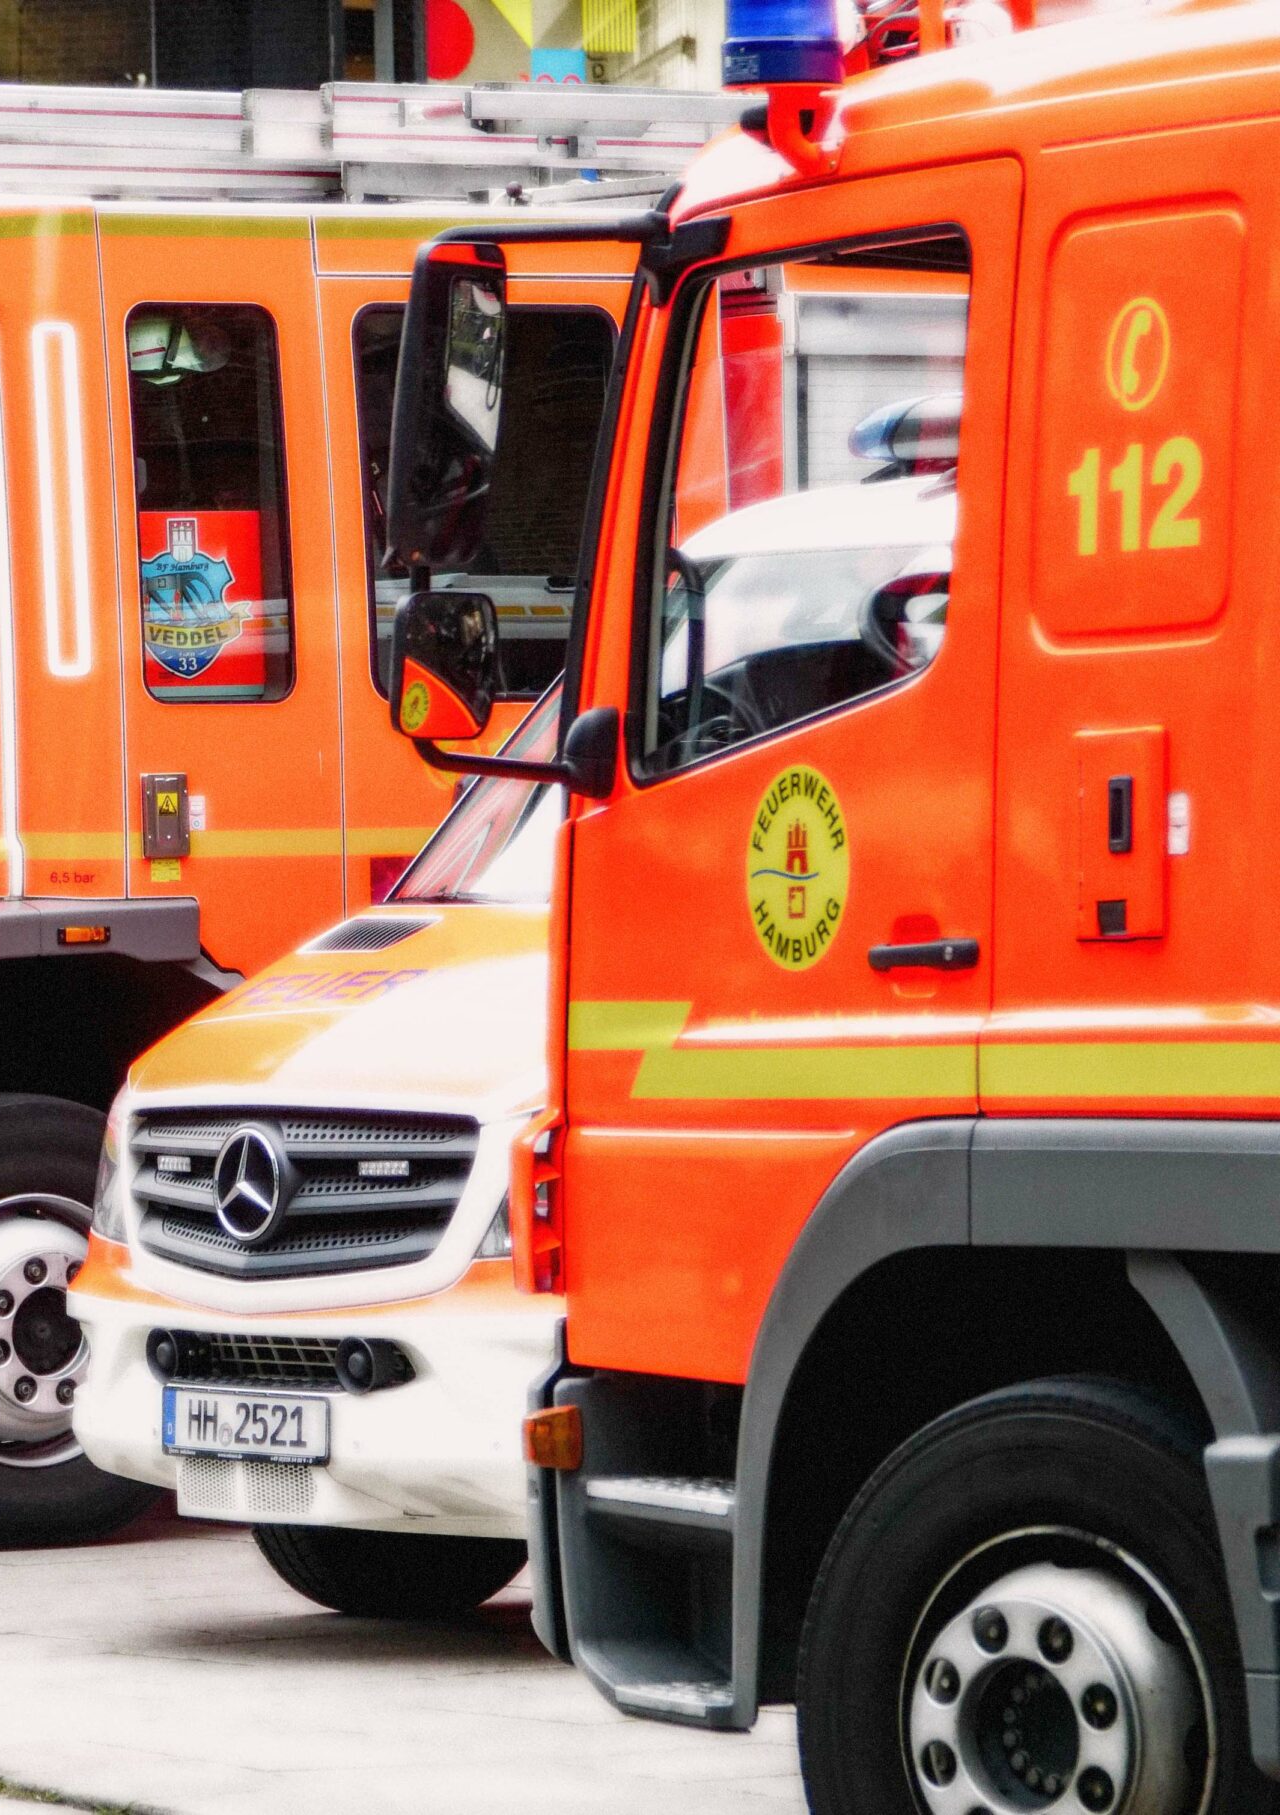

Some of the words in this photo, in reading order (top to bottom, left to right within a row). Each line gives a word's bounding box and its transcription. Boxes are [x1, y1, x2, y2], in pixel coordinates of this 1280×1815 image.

[1067, 436, 1202, 556] 112
[171, 560, 210, 572] Hamburg
[148, 626, 229, 646] VEDDEL
[178, 657, 198, 671] 33
[752, 772, 845, 853] FEUERWEHR
[50, 871, 70, 884] 6,5
[74, 871, 95, 883] bar
[754, 898, 841, 963] HAMBURG
[188, 1399, 218, 1442] HH
[233, 1402, 308, 1448] 2521
